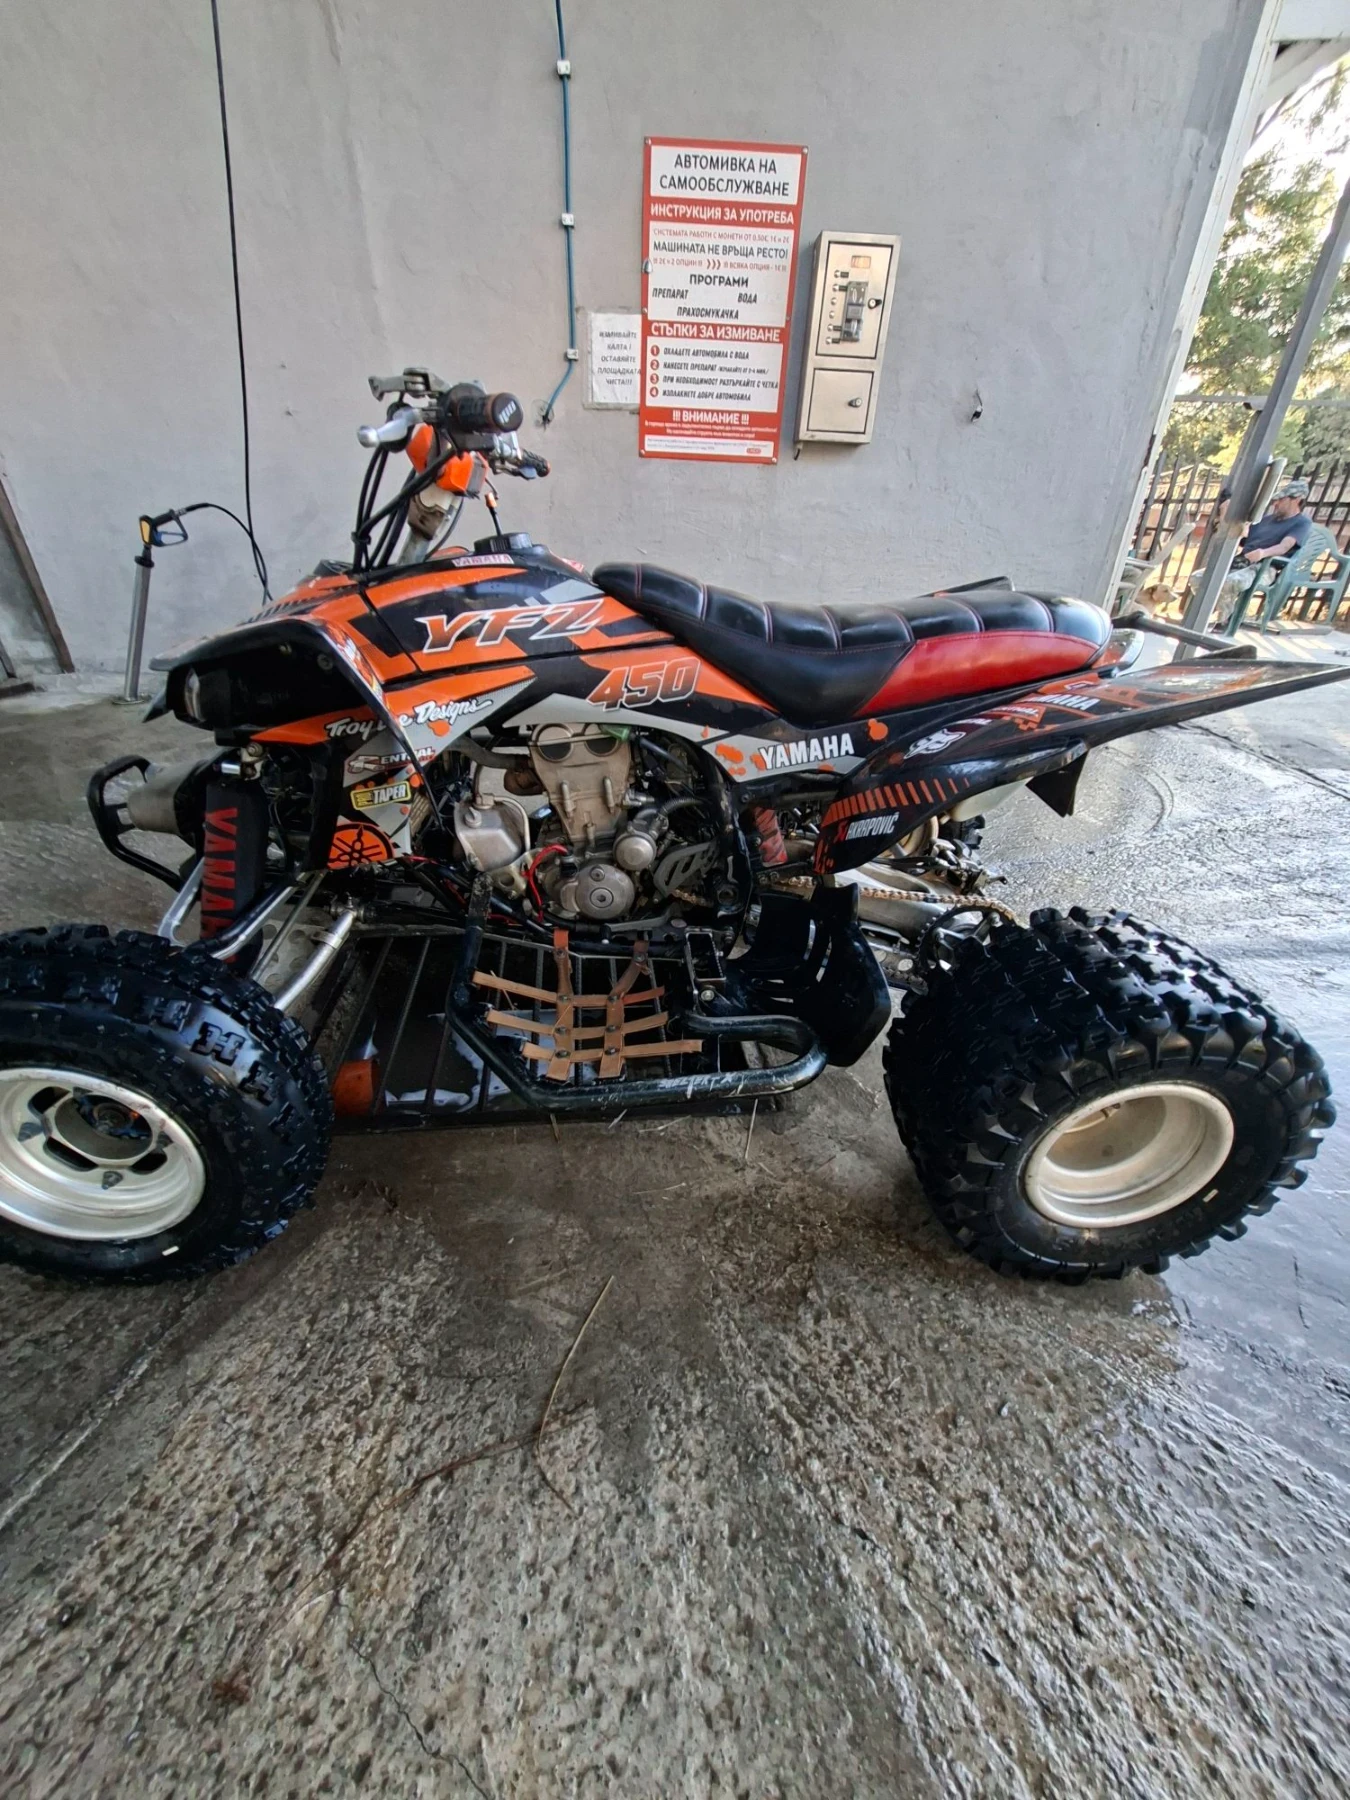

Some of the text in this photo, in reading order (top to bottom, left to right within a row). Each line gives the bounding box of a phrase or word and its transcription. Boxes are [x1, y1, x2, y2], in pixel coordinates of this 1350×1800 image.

[674, 153, 777, 174] АВТОМИВКА НА
[659, 174, 789, 197] САМООБСЛУЖВАНЕ
[650, 203, 794, 224] ИНСТРУКЦИЯ ЗА УПОТРЕБА
[653, 229, 688, 237] СИСТЕМАТА
[690, 230, 712, 238] РАБОТИ
[718, 232, 743, 240] МОНЕТИ
[653, 241, 706, 254] МАШИНАТА
[707, 244, 720, 255] НЕ
[722, 245, 754, 258] ВРЪЩА
[689, 273, 749, 288] ПРОГРАМИ
[652, 287, 758, 304] ПРЕПАРАТ ВОДА
[677, 306, 740, 319] ПРАХОСМУКАЧКА
[651, 322, 780, 342] СТЪПКИ ЗА ИЗМИВАНЕ
[682, 410, 740, 425] ВНИМАНИЕ
[414, 596, 606, 654] YFZ
[586, 656, 700, 713] 450
[325, 717, 374, 741] Troy
[414, 699, 493, 725] Designs
[757, 732, 855, 771] YAMAHA
[372, 784, 406, 804] TAPER
